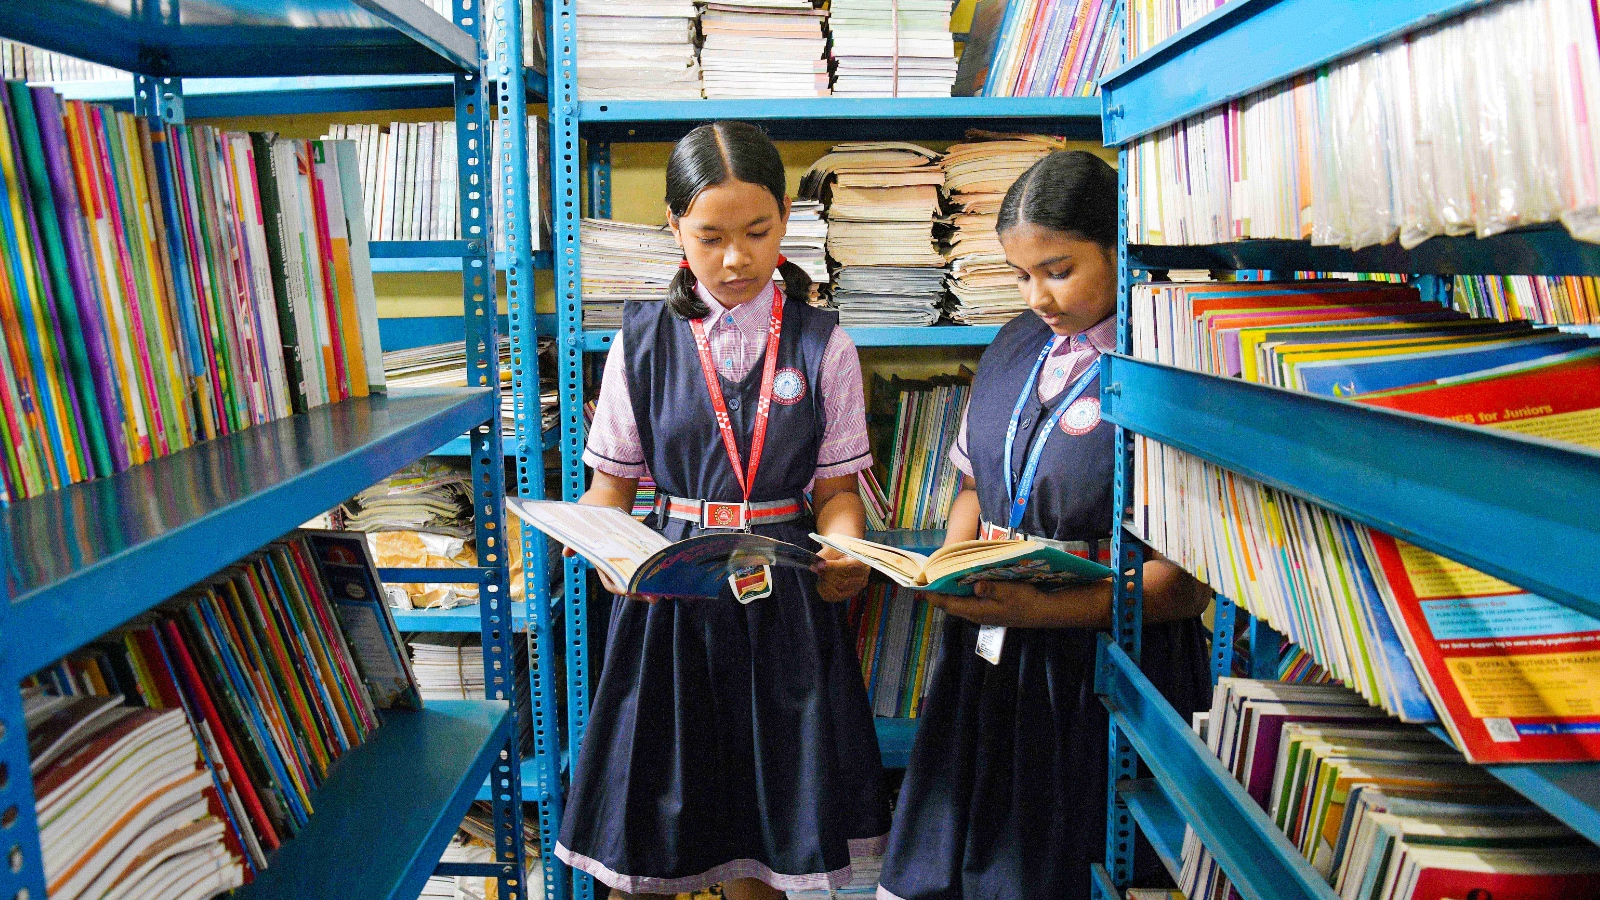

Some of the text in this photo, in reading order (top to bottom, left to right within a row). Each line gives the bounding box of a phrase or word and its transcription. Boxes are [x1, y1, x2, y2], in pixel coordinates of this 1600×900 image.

[295, 346, 300, 361] 3
[1478, 412, 1497, 422] for
[1503, 404, 1552, 419] Juniors
